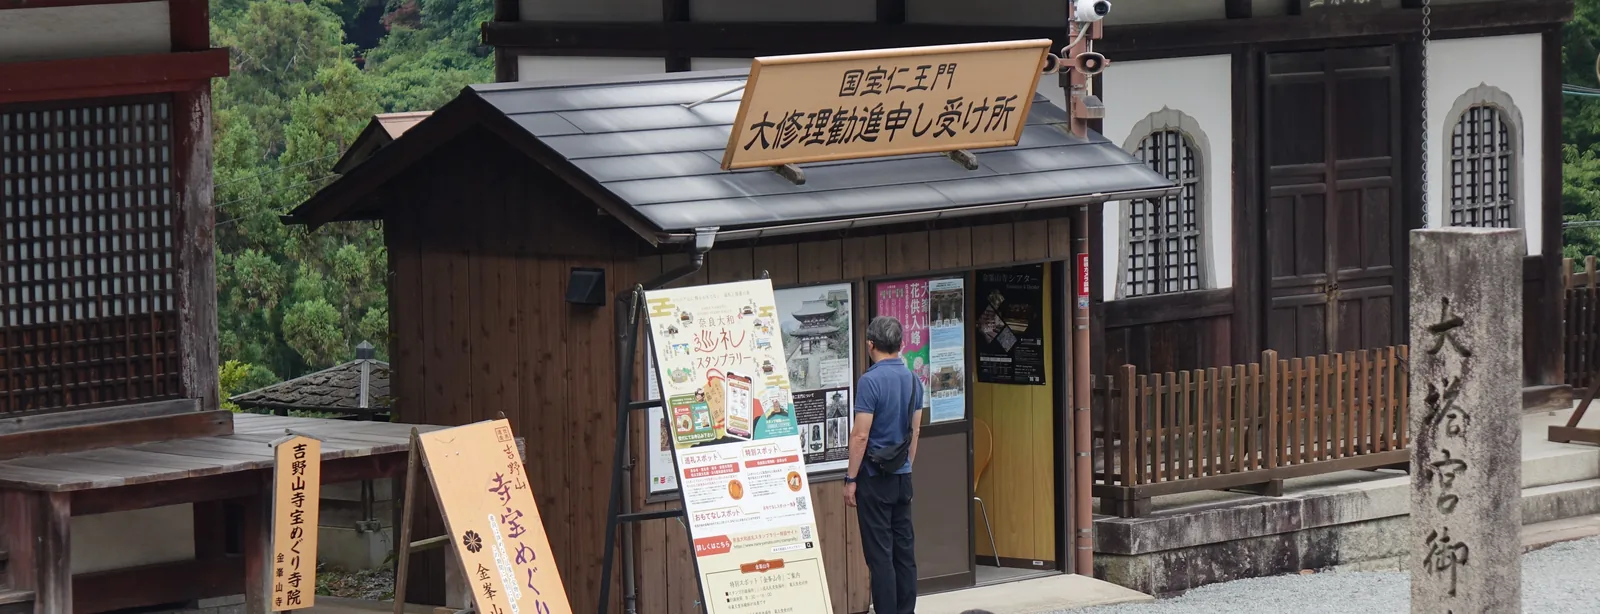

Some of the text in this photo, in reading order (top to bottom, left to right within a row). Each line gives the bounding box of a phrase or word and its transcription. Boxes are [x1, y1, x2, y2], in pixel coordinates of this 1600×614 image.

[839, 62, 957, 97] 国宝仁王門
[743, 94, 1019, 151] 大修理勧進申し受け所
[698, 315, 735, 328] 奈良大和
[693, 328, 745, 353] 巡礼
[696, 355, 752, 369] スタンプラリー
[684, 453, 718, 465] 巡礼スポット
[744, 446, 778, 458] 特別スポット
[1424, 296, 1472, 614] 大塔宮御
[503, 444, 526, 490] 吉野山
[286, 443, 308, 606] 吉野山寺宝めぐり寺院
[694, 509, 741, 521] おもてなしスポット
[696, 540, 730, 551] 詳しくはこちら
[275, 552, 285, 607] 金峯山寺
